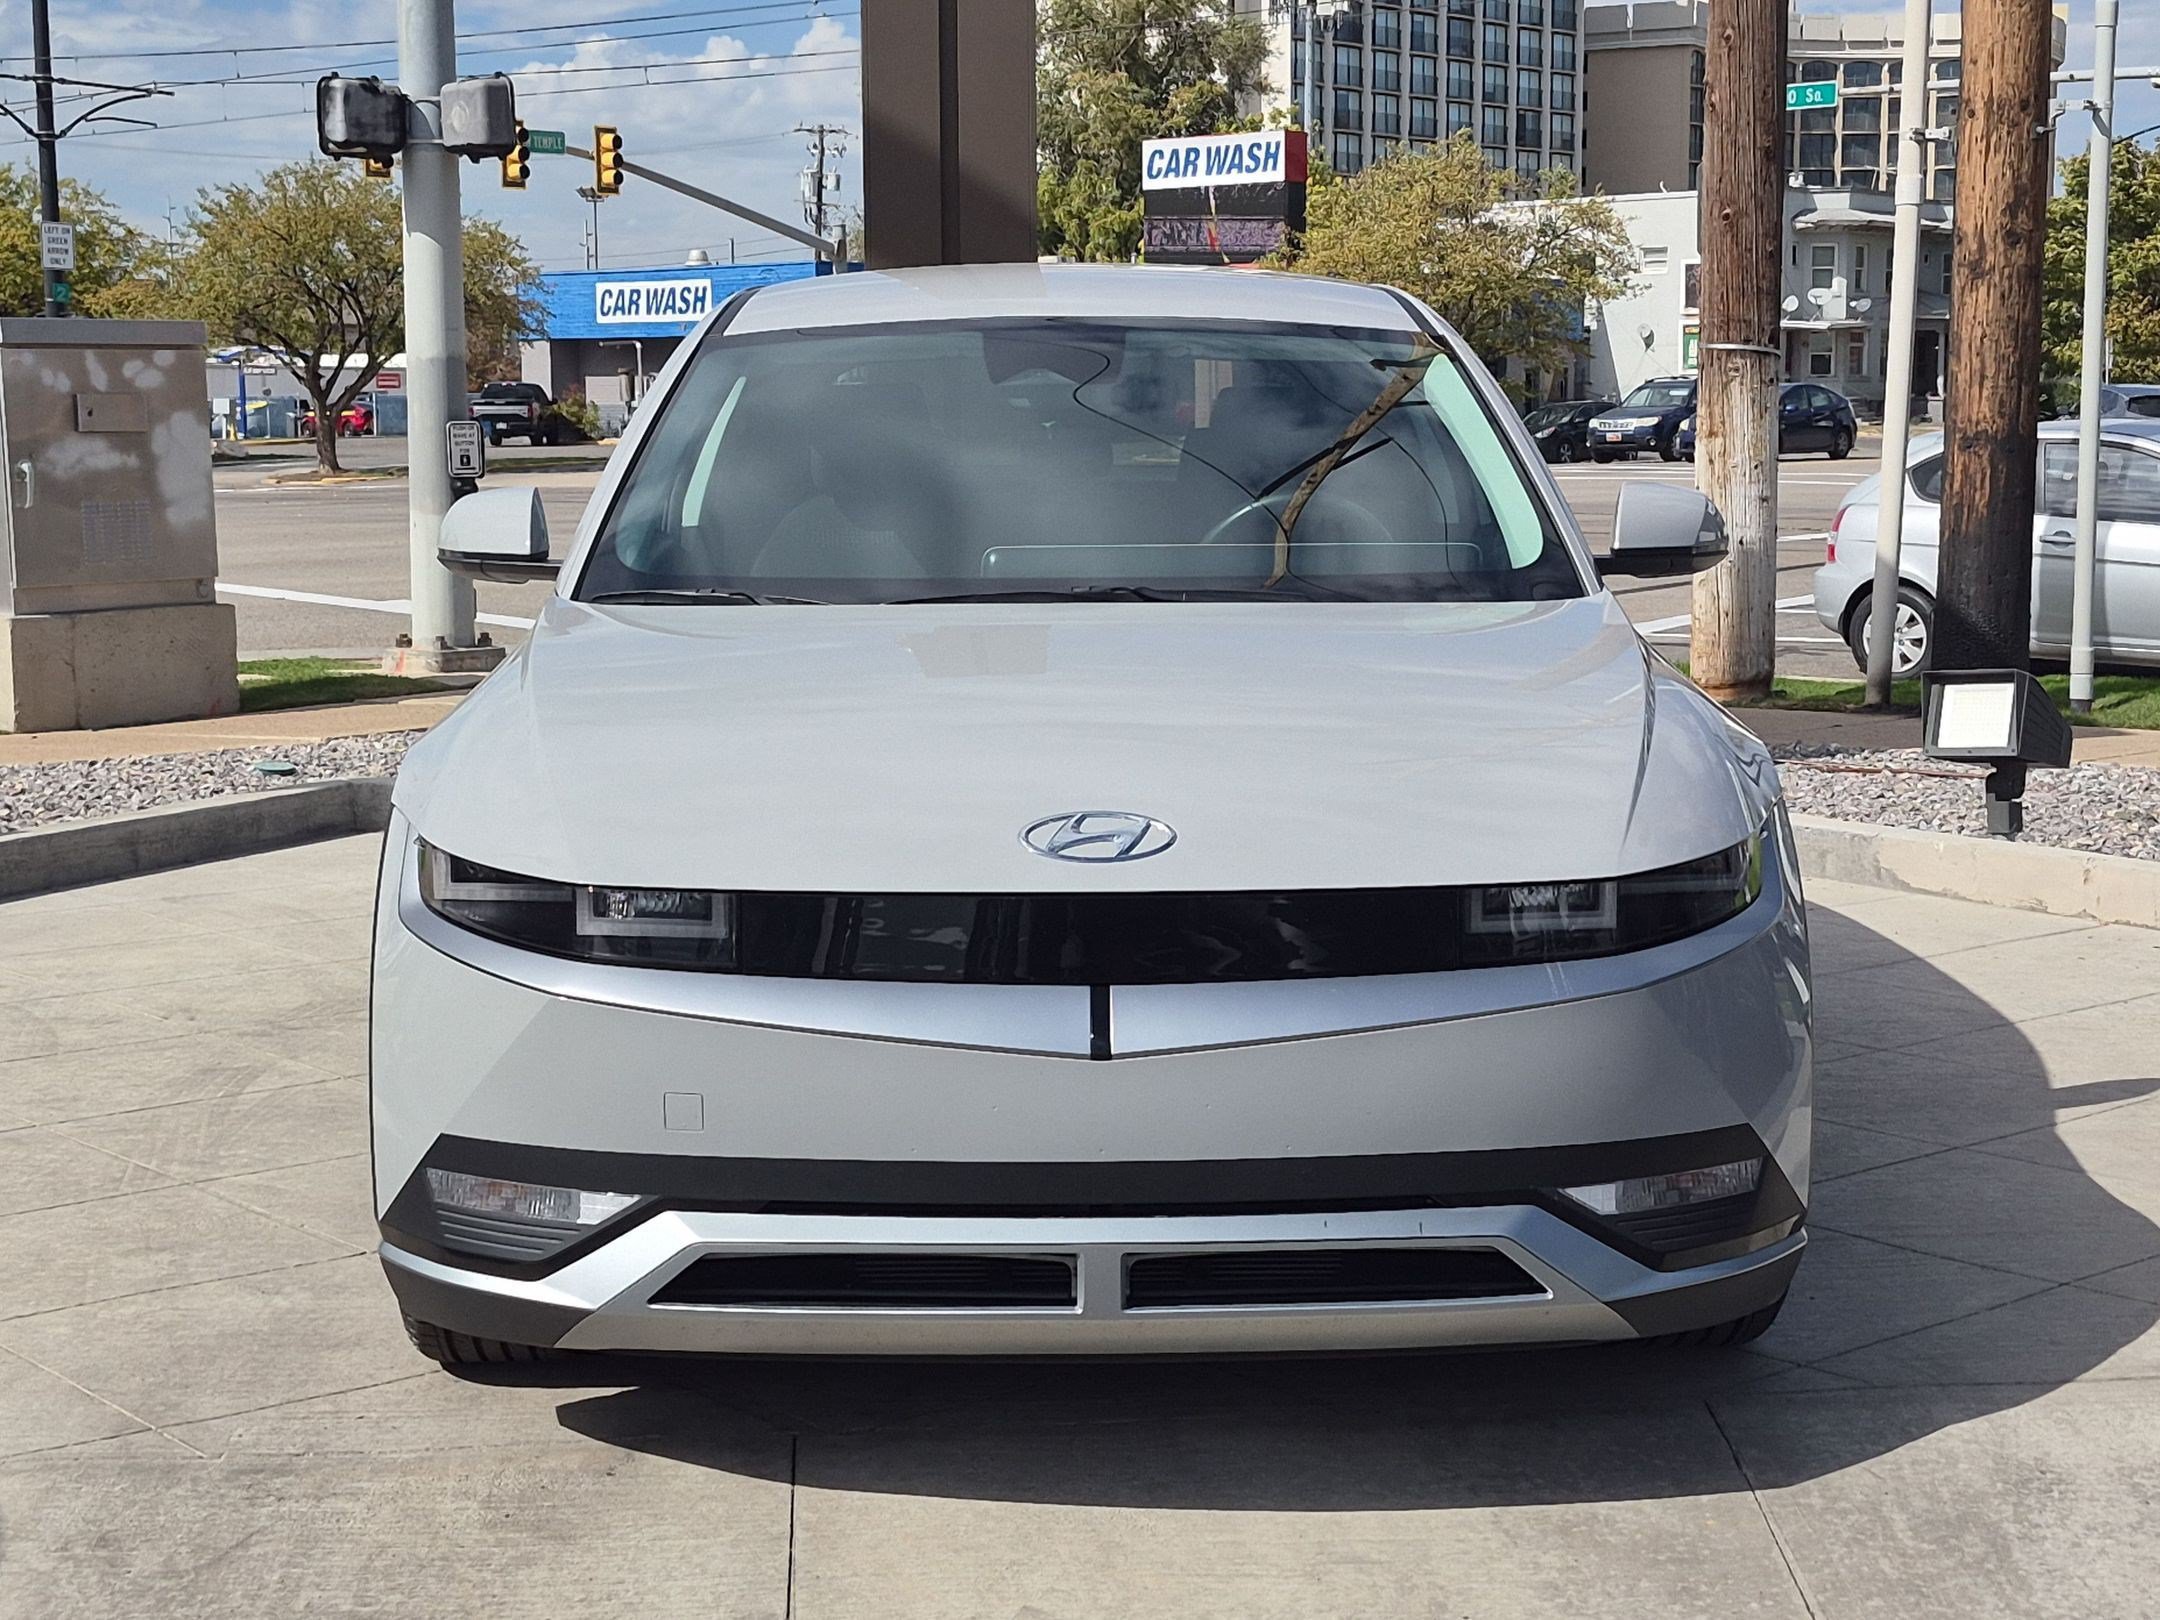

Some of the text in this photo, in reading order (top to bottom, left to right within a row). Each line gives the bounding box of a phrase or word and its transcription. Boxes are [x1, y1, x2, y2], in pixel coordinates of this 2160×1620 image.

[532, 135, 563, 150] TEMPLE
[1147, 141, 1281, 180] CAR WASH
[44, 225, 59, 234] LEFT
[600, 286, 708, 317] CAR WASH
